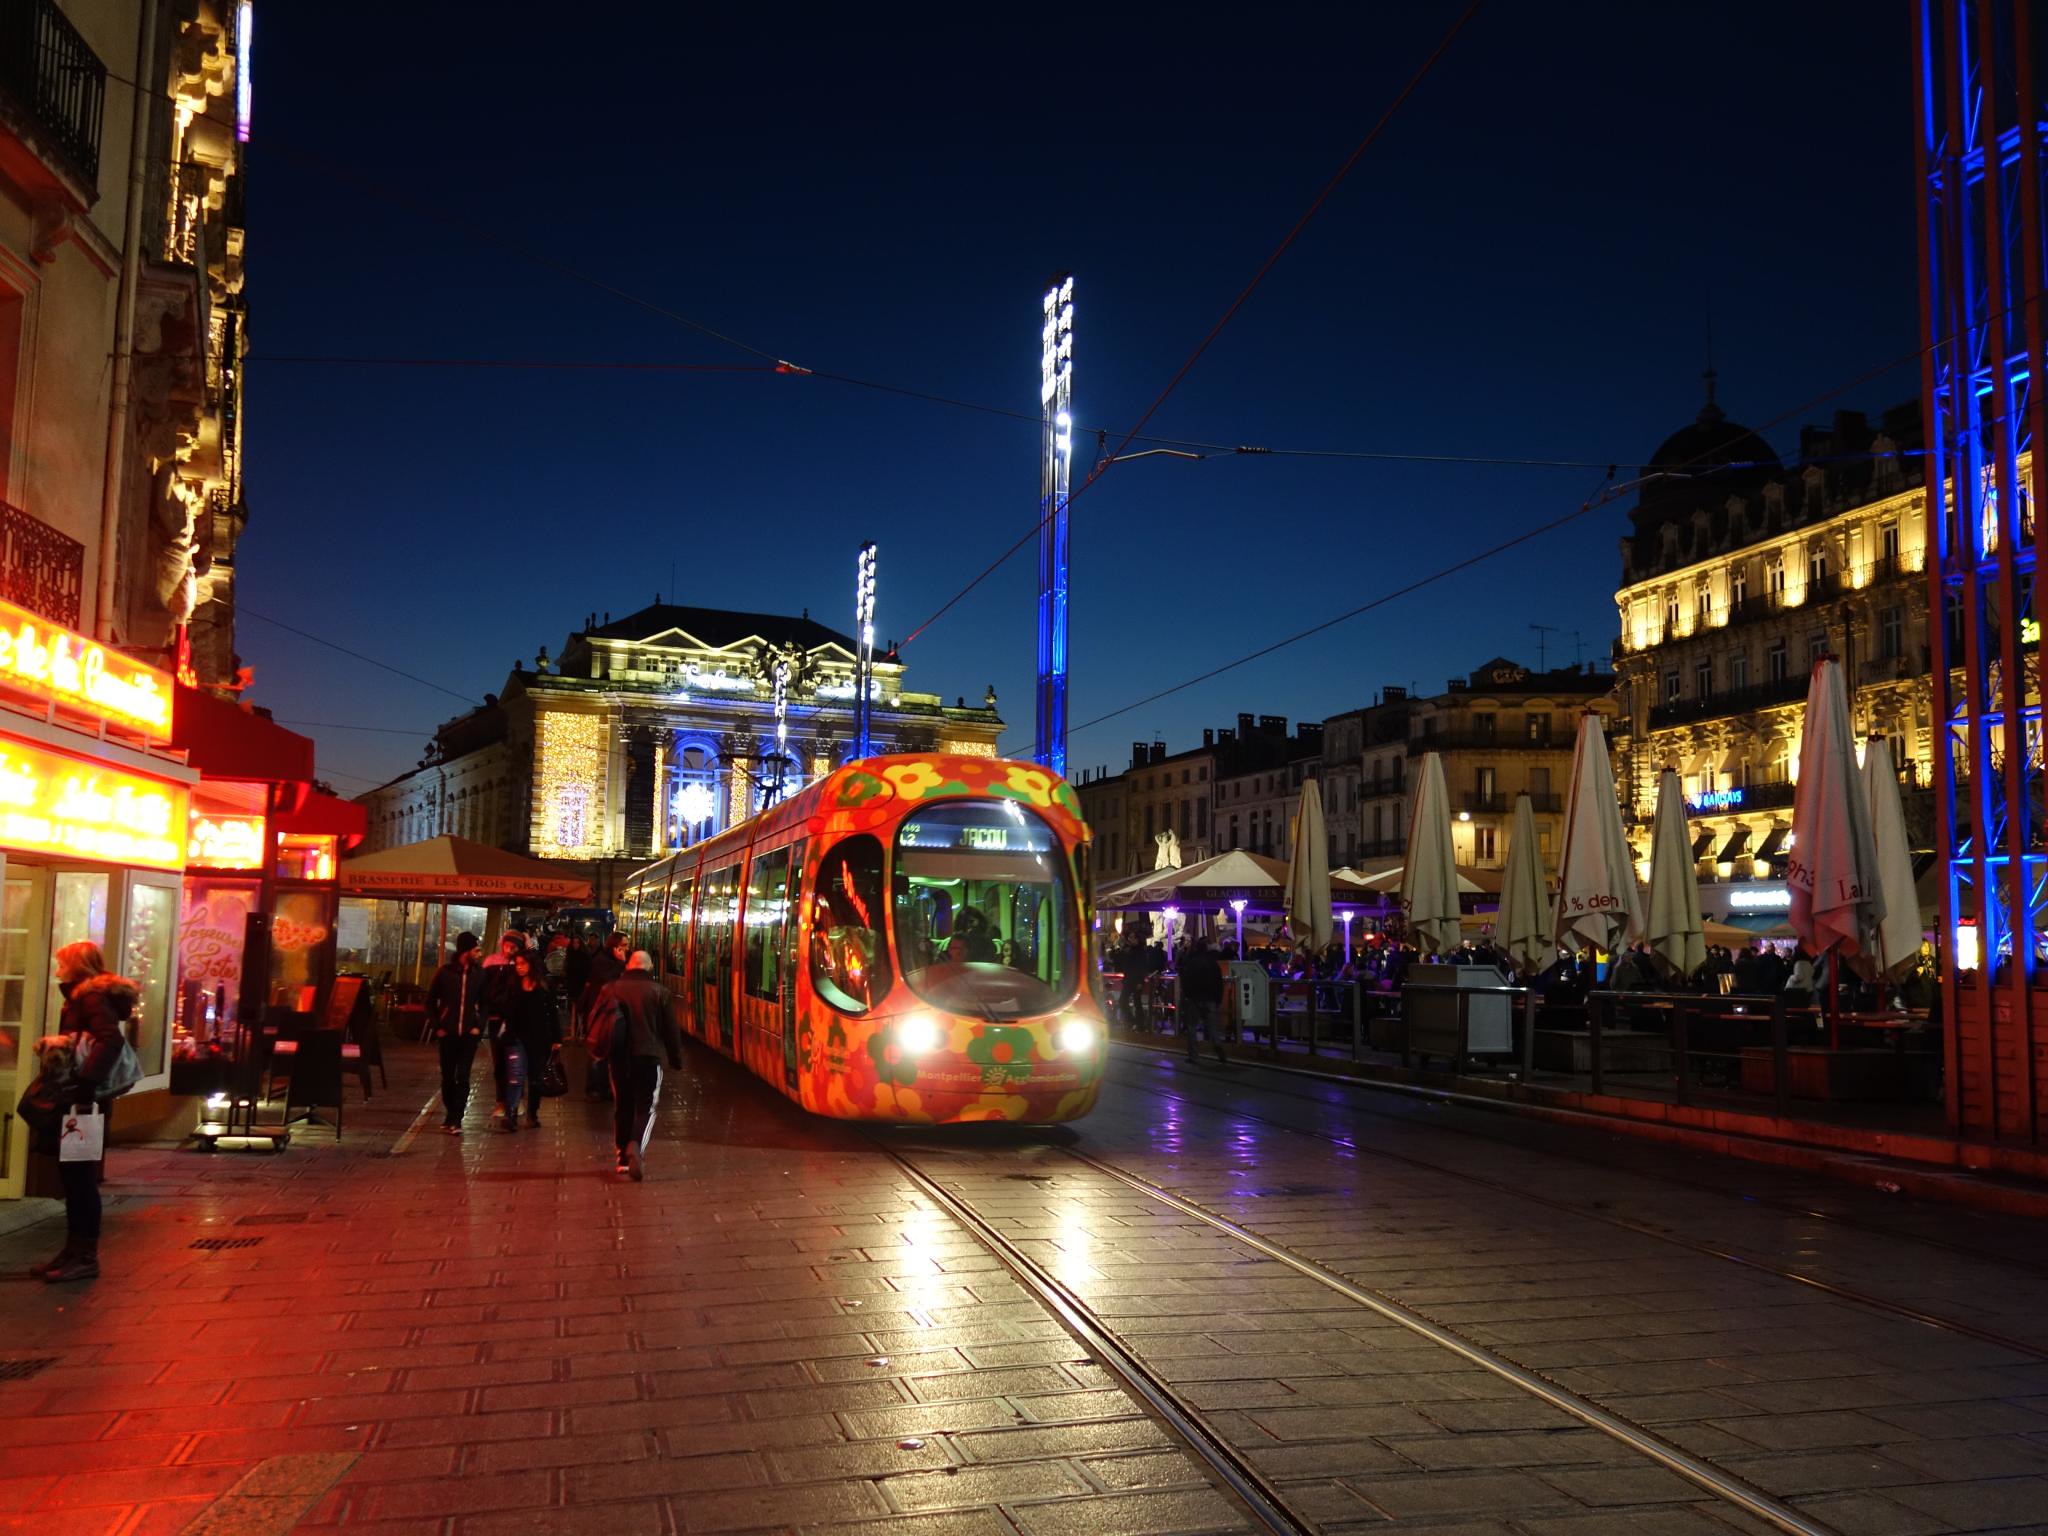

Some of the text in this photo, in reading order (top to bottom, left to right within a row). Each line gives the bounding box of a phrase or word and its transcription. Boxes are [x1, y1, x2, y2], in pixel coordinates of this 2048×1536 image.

[1703, 790, 1742, 807] BARCLAYS
[959, 827, 1007, 849] JACOU
[349, 874, 565, 892] BRASSERIE LES TROIS GRACES
[916, 1070, 982, 1083] Montpellier
